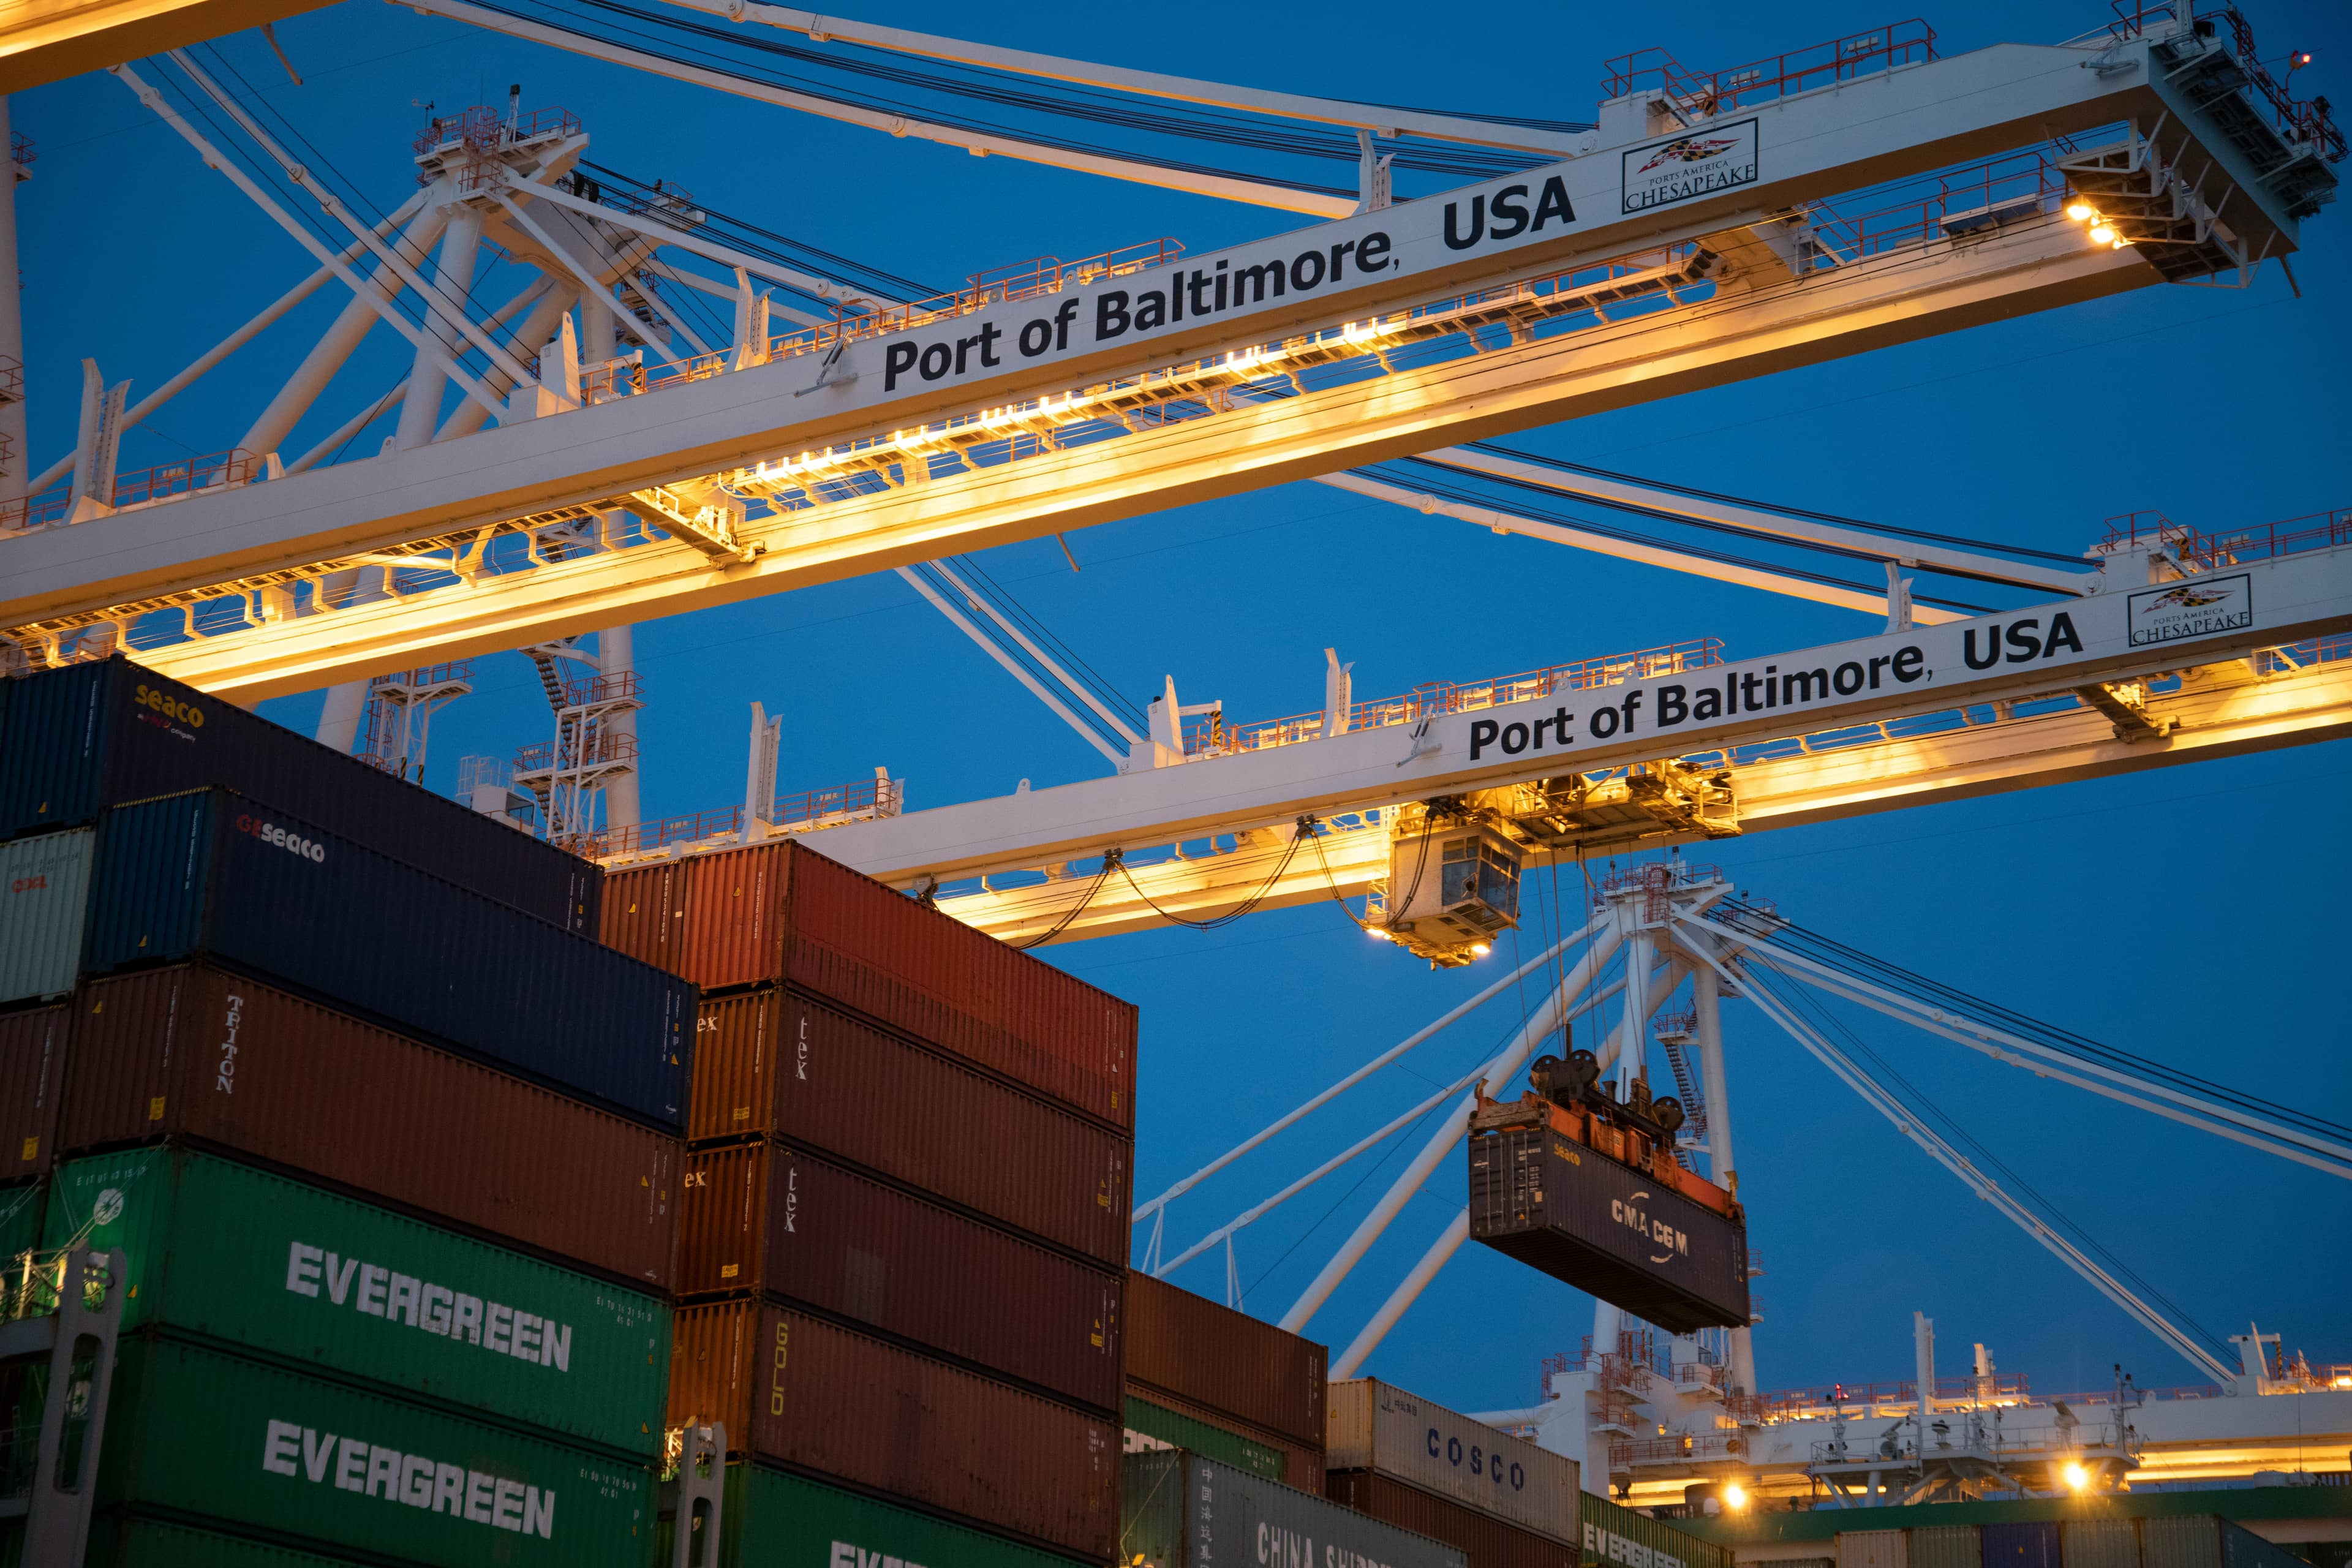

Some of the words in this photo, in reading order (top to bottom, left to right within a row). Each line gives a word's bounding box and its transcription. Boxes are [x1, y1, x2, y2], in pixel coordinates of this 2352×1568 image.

[1626, 164, 1754, 209] CHESAPEAKE
[1650, 173, 1679, 186] PORTS
[1682, 160, 1728, 178] AMERICA
[884, 321, 1003, 392] Port
[1019, 297, 1080, 357] of
[1095, 232, 1400, 342] Baltimore,
[1443, 175, 1577, 251] USA
[2132, 611, 2248, 643] CHESAPEAKE
[2154, 614, 2180, 625] PORTS
[2183, 607, 2225, 620] AMERICA
[134, 684, 205, 728] seaco
[1470, 706, 1575, 761] Port
[1589, 690, 1643, 739] of
[1657, 645, 1934, 728] Baltimore,
[1964, 611, 2084, 671] USA
[215, 994, 244, 1095] TRITON
[696, 1016, 718, 1033] ex
[795, 1016, 809, 1081] tex
[685, 1170, 706, 1188] ex
[1553, 1143, 1581, 1167] seaco
[783, 1166, 798, 1234] tex
[1611, 1199, 1649, 1237] CMA
[1652, 1219, 1688, 1256] CGM
[285, 1241, 572, 1373] EVERGREEN
[770, 1321, 789, 1417] GOLD
[262, 1419, 556, 1539] EVERGREEN
[1427, 1428, 1525, 1492] COSCO
[1257, 1521, 1314, 1568] CHINA
